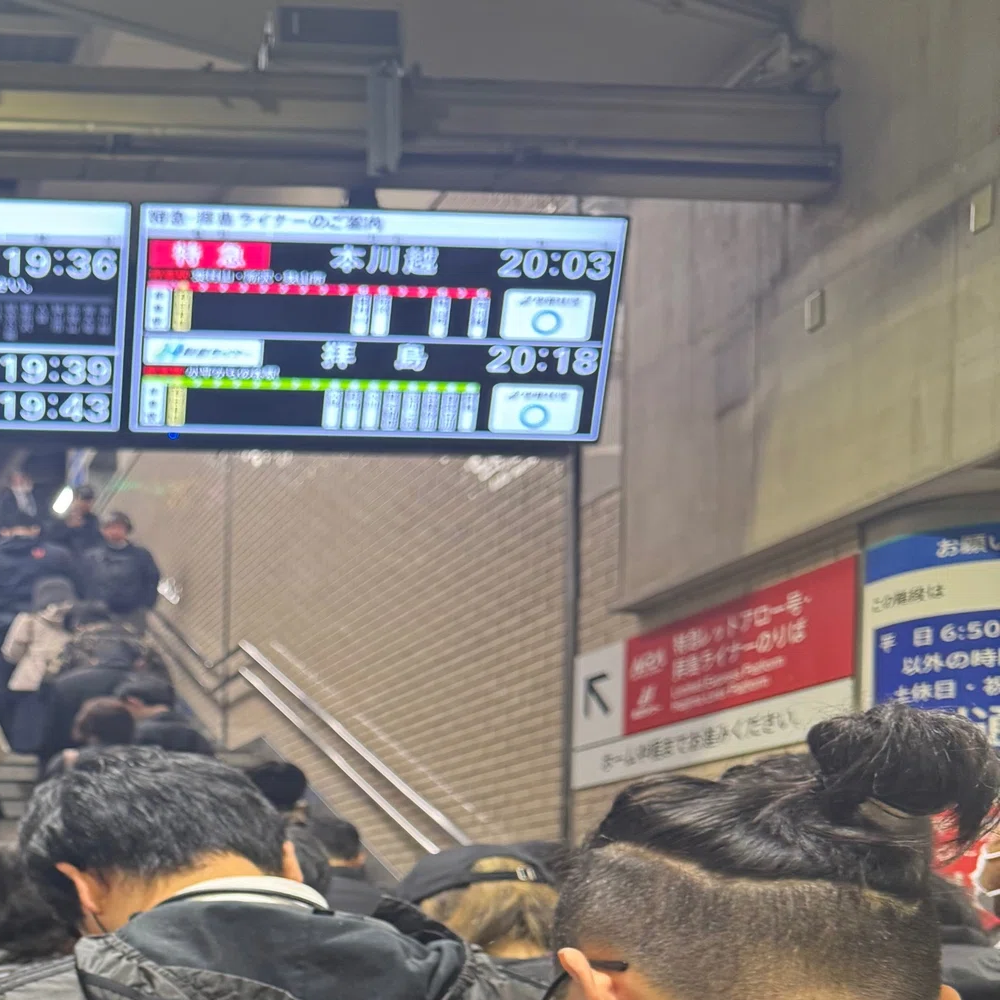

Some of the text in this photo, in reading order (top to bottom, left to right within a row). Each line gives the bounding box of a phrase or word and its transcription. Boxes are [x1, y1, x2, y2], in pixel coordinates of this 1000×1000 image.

[2, 246, 119, 282] 19:36
[329, 243, 441, 276] 本川越
[497, 248, 612, 281] 20:03
[0, 352, 113, 387] 19:39
[485, 344, 600, 376] 20:18
[901, 648, 1000, 676] 以外の時
